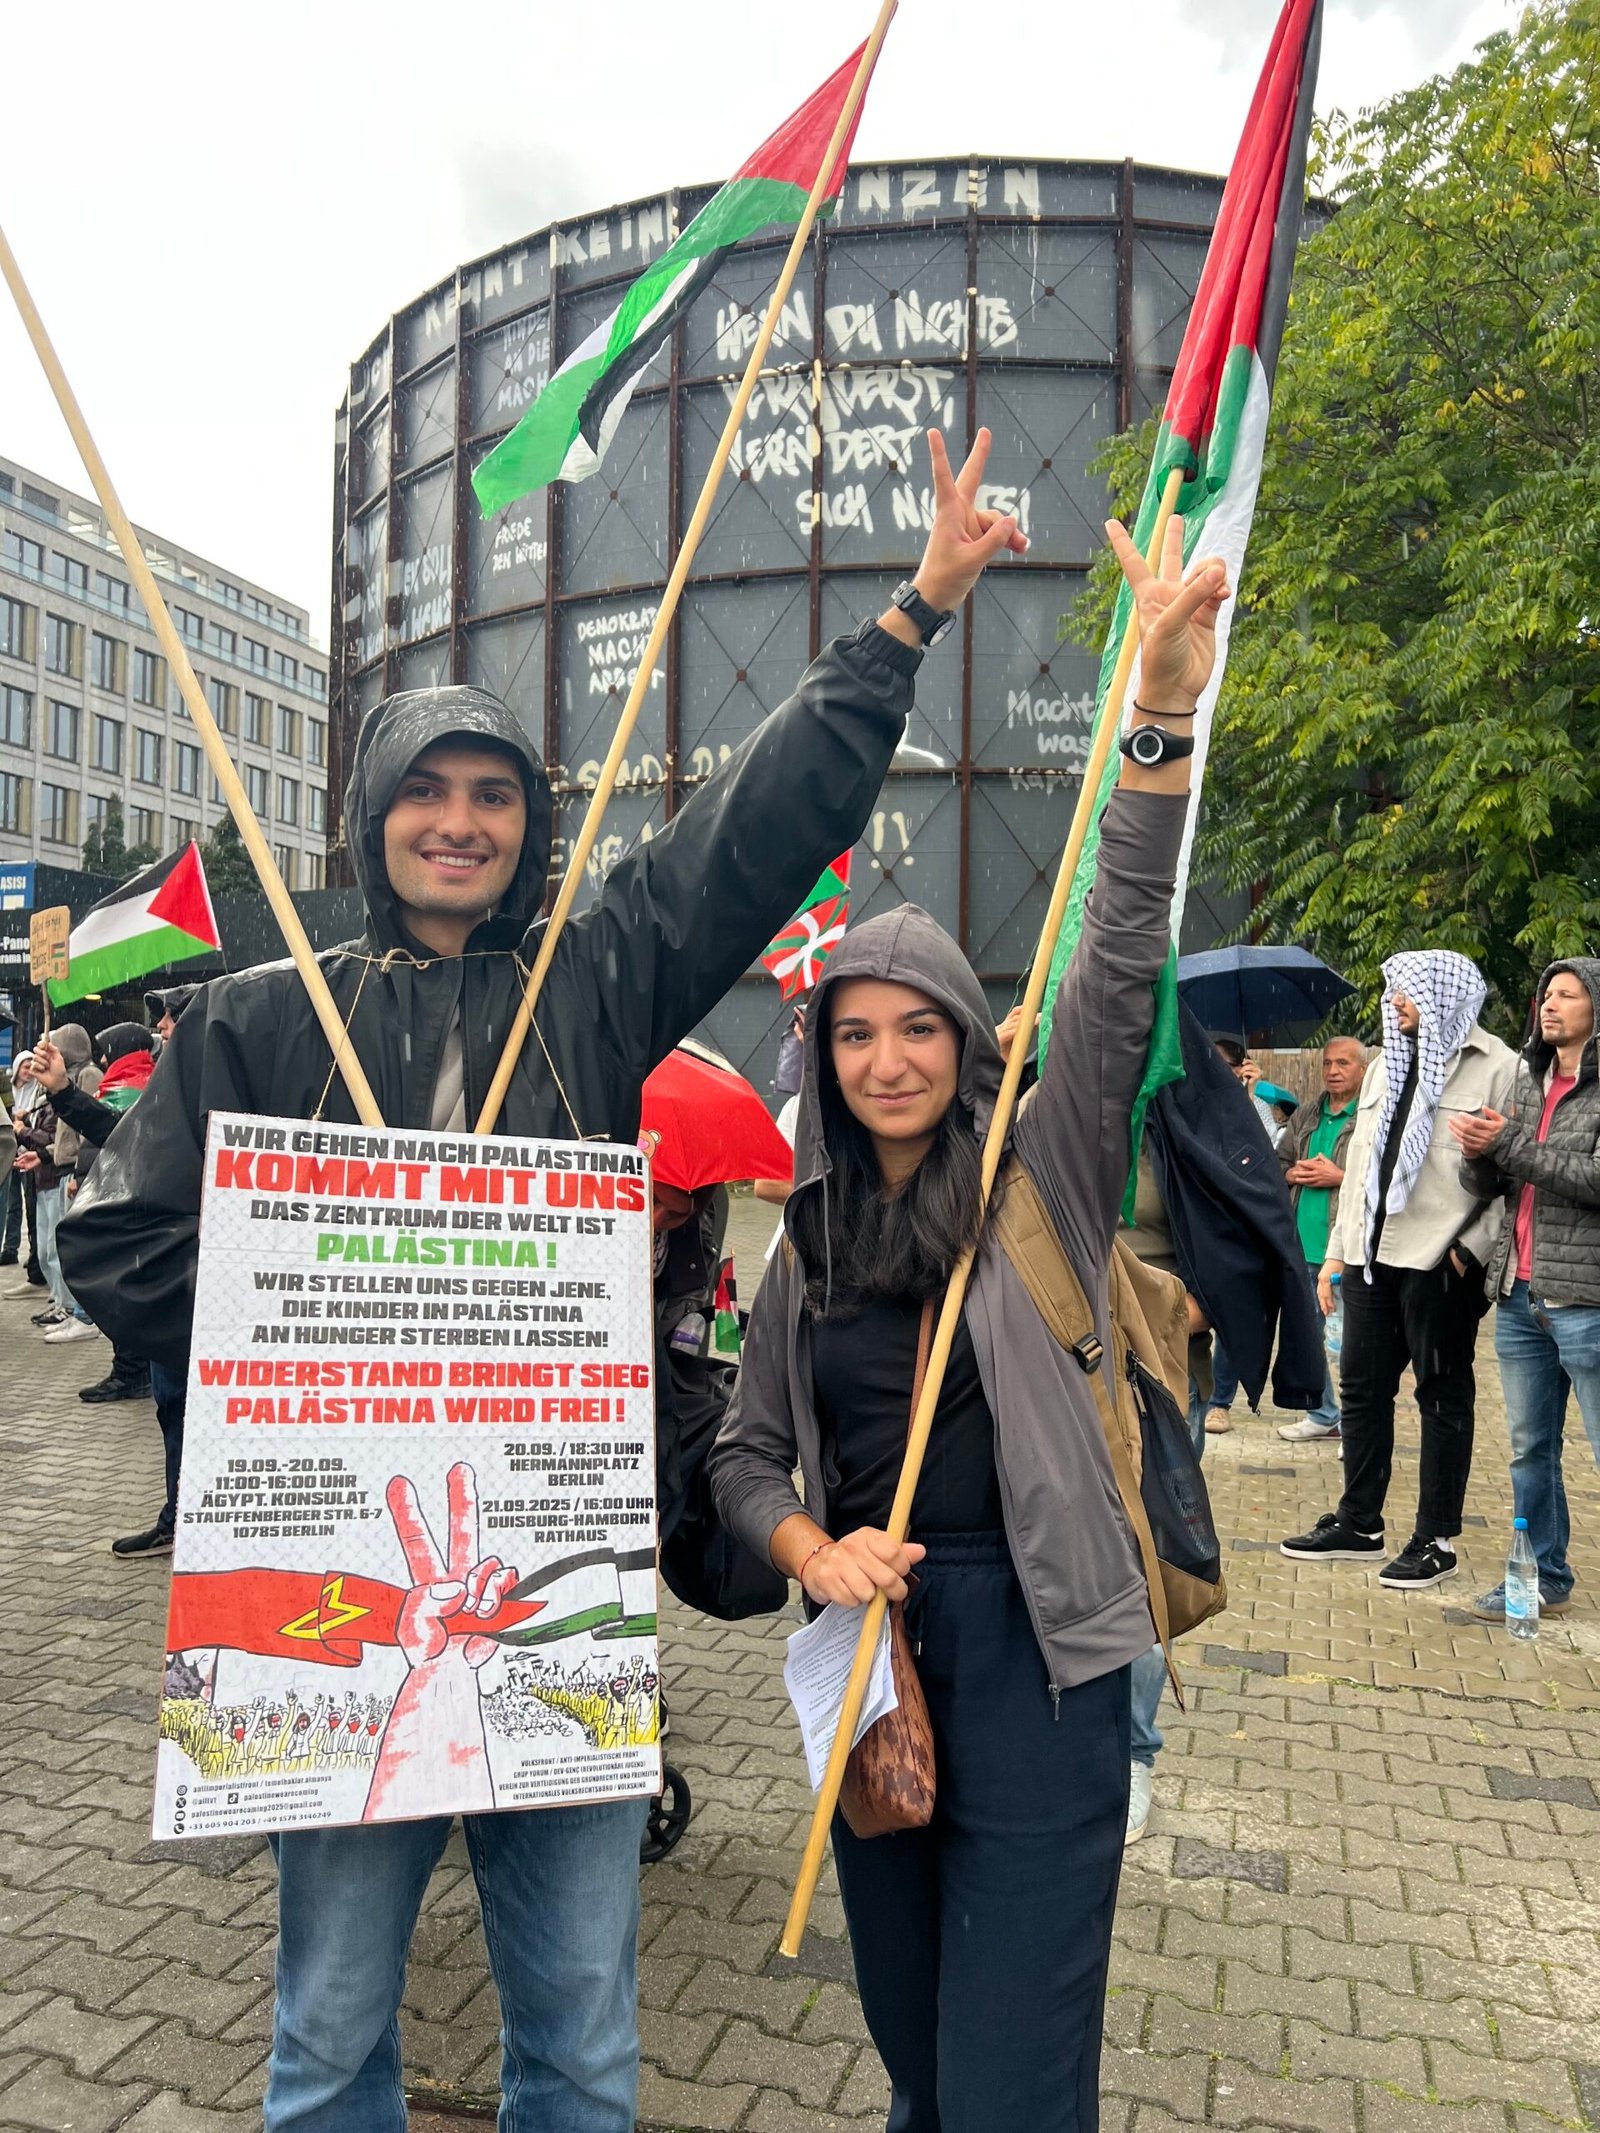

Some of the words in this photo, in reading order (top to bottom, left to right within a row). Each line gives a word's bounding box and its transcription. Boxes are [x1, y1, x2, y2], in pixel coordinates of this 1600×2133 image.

[825, 303, 883, 353] DU
[795, 484, 874, 535] SICH
[892, 482, 1031, 535] NITS!
[577, 606, 659, 644] DEMOKRAT
[588, 634, 650, 667] MACH
[589, 667, 665, 695] ARBET
[1037, 732, 1091, 756] was
[223, 1124, 287, 1151] WIR
[292, 1131, 390, 1159] GEHEN
[394, 1138, 477, 1164] NACH
[482, 1144, 643, 1175] PALÄSTINA!
[215, 1150, 430, 1200] KOMMT
[440, 1166, 536, 1206] MIT
[546, 1171, 645, 1212] UNS
[250, 1199, 309, 1222] DAS
[314, 1203, 442, 1228] ZENTRUM
[452, 1210, 503, 1231] DER
[507, 1213, 572, 1234] WELT
[576, 1217, 616, 1236] IST
[254, 1272, 304, 1291] WIR
[309, 1274, 413, 1294] STELLEN
[417, 1278, 468, 1296] UNS
[472, 1280, 546, 1298] GEGEN
[550, 1281, 611, 1301] JENE,
[282, 1300, 322, 1318] DIE
[326, 1301, 419, 1320] KINDER
[423, 1303, 450, 1321] IN
[453, 1300, 583, 1323] PALÄSTINA
[252, 1325, 292, 1343] AN
[295, 1326, 396, 1345] HUNGER
[400, 1328, 510, 1346] STERBEN
[514, 1330, 608, 1348] LASSEN!
[198, 1360, 442, 1388] WIDERSTAND
[449, 1362, 574, 1388] BRINGT
[581, 1364, 649, 1389] SIEG
[226, 1391, 436, 1424] PALÄSTINA
[445, 1398, 535, 1423] WIRD
[504, 1443, 556, 1456] 20.09.
[569, 1443, 611, 1455] 18:30
[614, 1442, 645, 1454] UHR
[227, 1458, 347, 1473] 19.09.-20.09.
[510, 1458, 639, 1471] HERMANNPLATZ
[216, 1475, 317, 1490] 11:00-16:00
[320, 1474, 357, 1488] UHR
[548, 1473, 604, 1486] BERLIN
[201, 1490, 268, 1507] ÄGYPT.
[271, 1491, 368, 1506] KONSULAT
[482, 1499, 571, 1512] 21.09.2025
[583, 1498, 623, 1510] 16:00
[626, 1497, 654, 1509] UHR
[183, 1511, 321, 1523] STAUFFENBERGER
[323, 1509, 357, 1520] STR.
[359, 1508, 383, 1519] 6-7
[487, 1513, 650, 1528] DUISBURG-HAMBORN
[233, 1526, 279, 1538] 10785
[282, 1525, 335, 1537] BERLIN
[535, 1529, 608, 1543] RATHAUS
